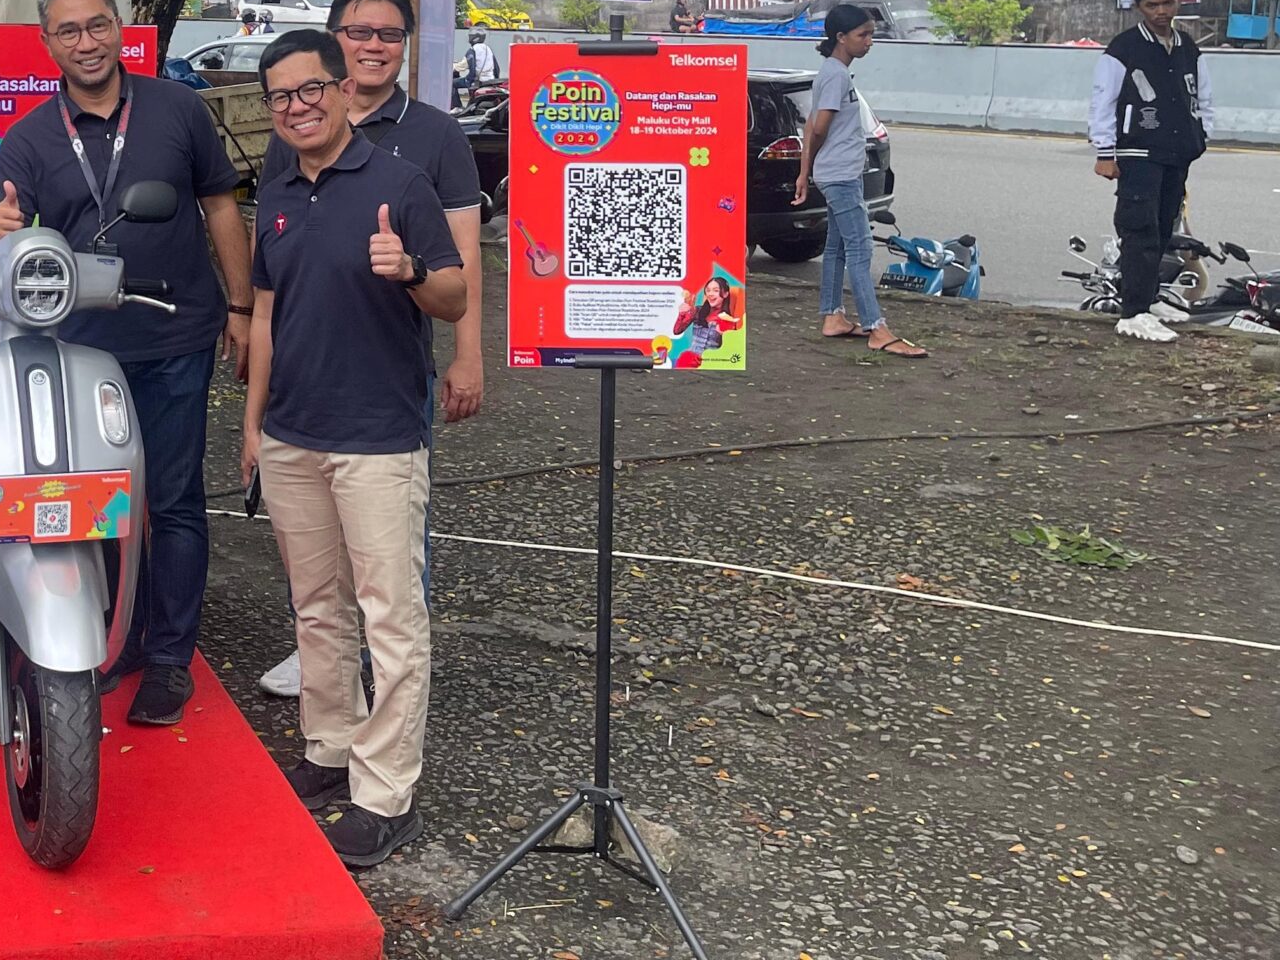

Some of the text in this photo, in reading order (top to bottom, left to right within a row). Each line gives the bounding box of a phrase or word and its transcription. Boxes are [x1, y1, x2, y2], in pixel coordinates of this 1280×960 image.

[668, 53, 737, 67] Telkomsel
[551, 81, 602, 102] Poin
[625, 91, 717, 102] Datang dan Rasakan
[531, 101, 621, 123] Festival
[651, 101, 692, 112] Hepi-mu
[637, 115, 711, 127] Maluku City Mall
[629, 126, 718, 135] 18-19 Oktober 2024
[513, 356, 535, 365] Poin
